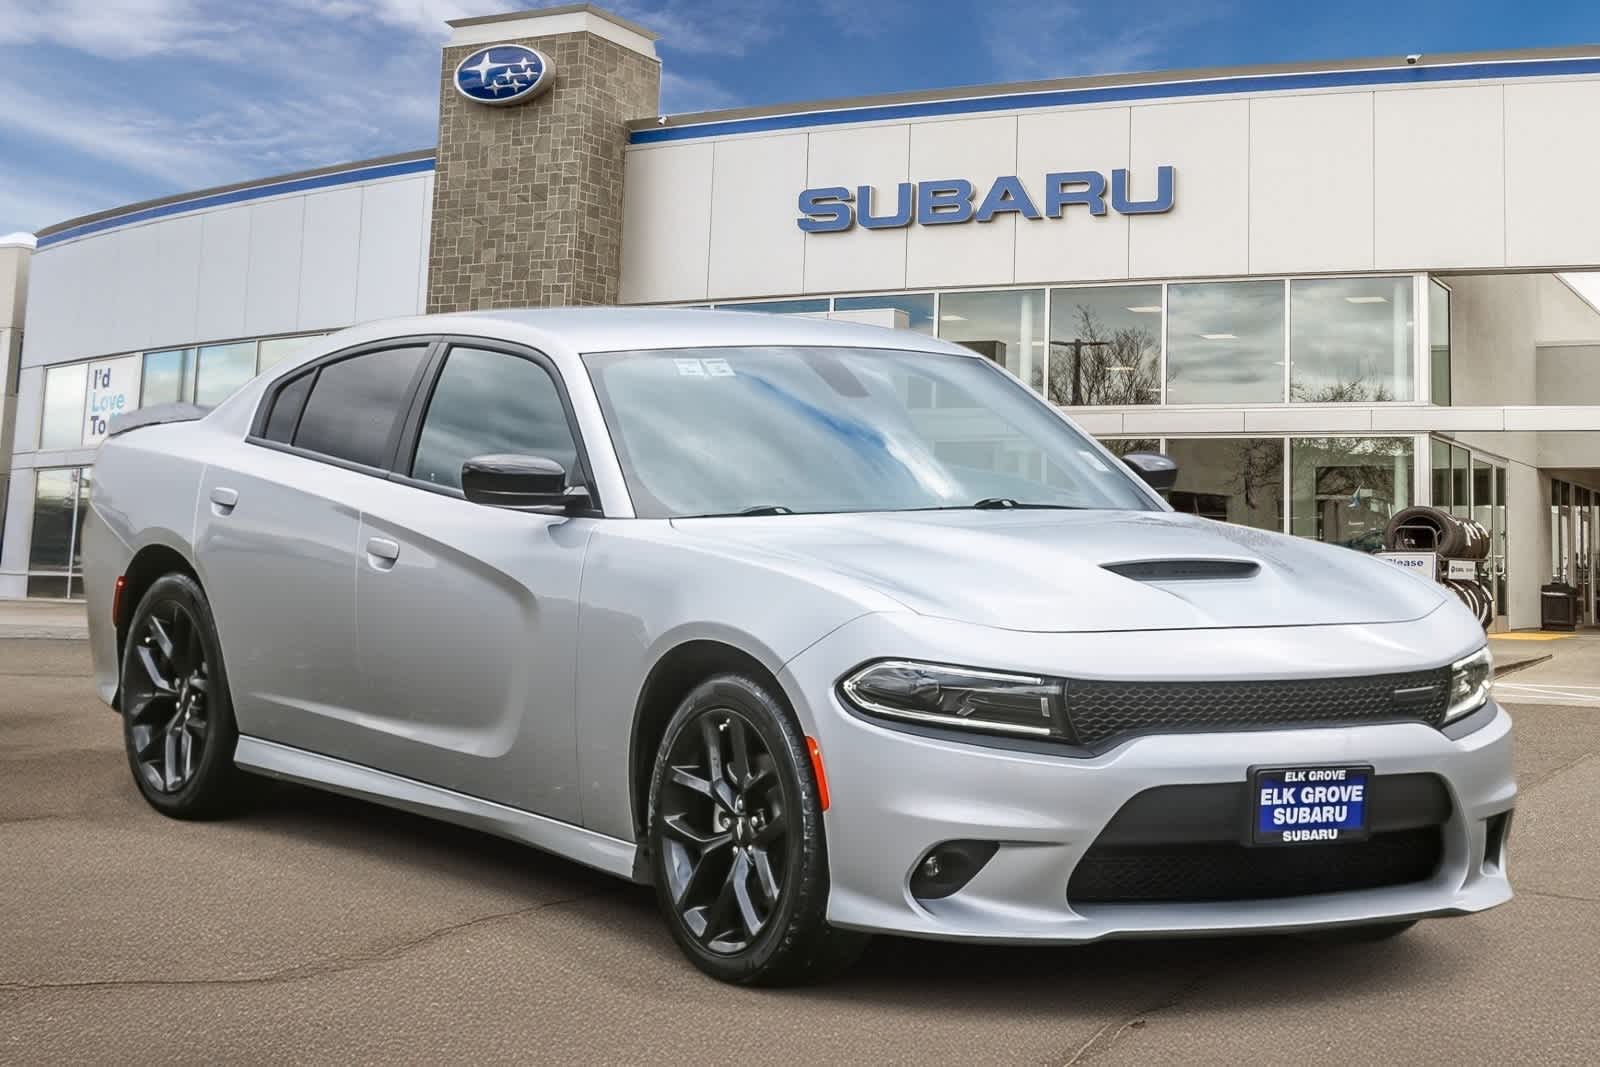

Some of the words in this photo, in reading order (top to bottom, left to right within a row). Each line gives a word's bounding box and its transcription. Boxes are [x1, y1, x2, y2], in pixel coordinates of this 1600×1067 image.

[797, 165, 1175, 233] SUBARU
[93, 368, 111, 389] I'd
[91, 391, 125, 412] Love
[90, 415, 106, 435] To
[1285, 771, 1306, 782] ELK
[1308, 770, 1346, 781] GROVE
[1261, 788, 1296, 806] ELK
[1300, 785, 1364, 804] GROVE
[1273, 806, 1348, 825] SUBARU
[1283, 829, 1338, 841] SUBARU
